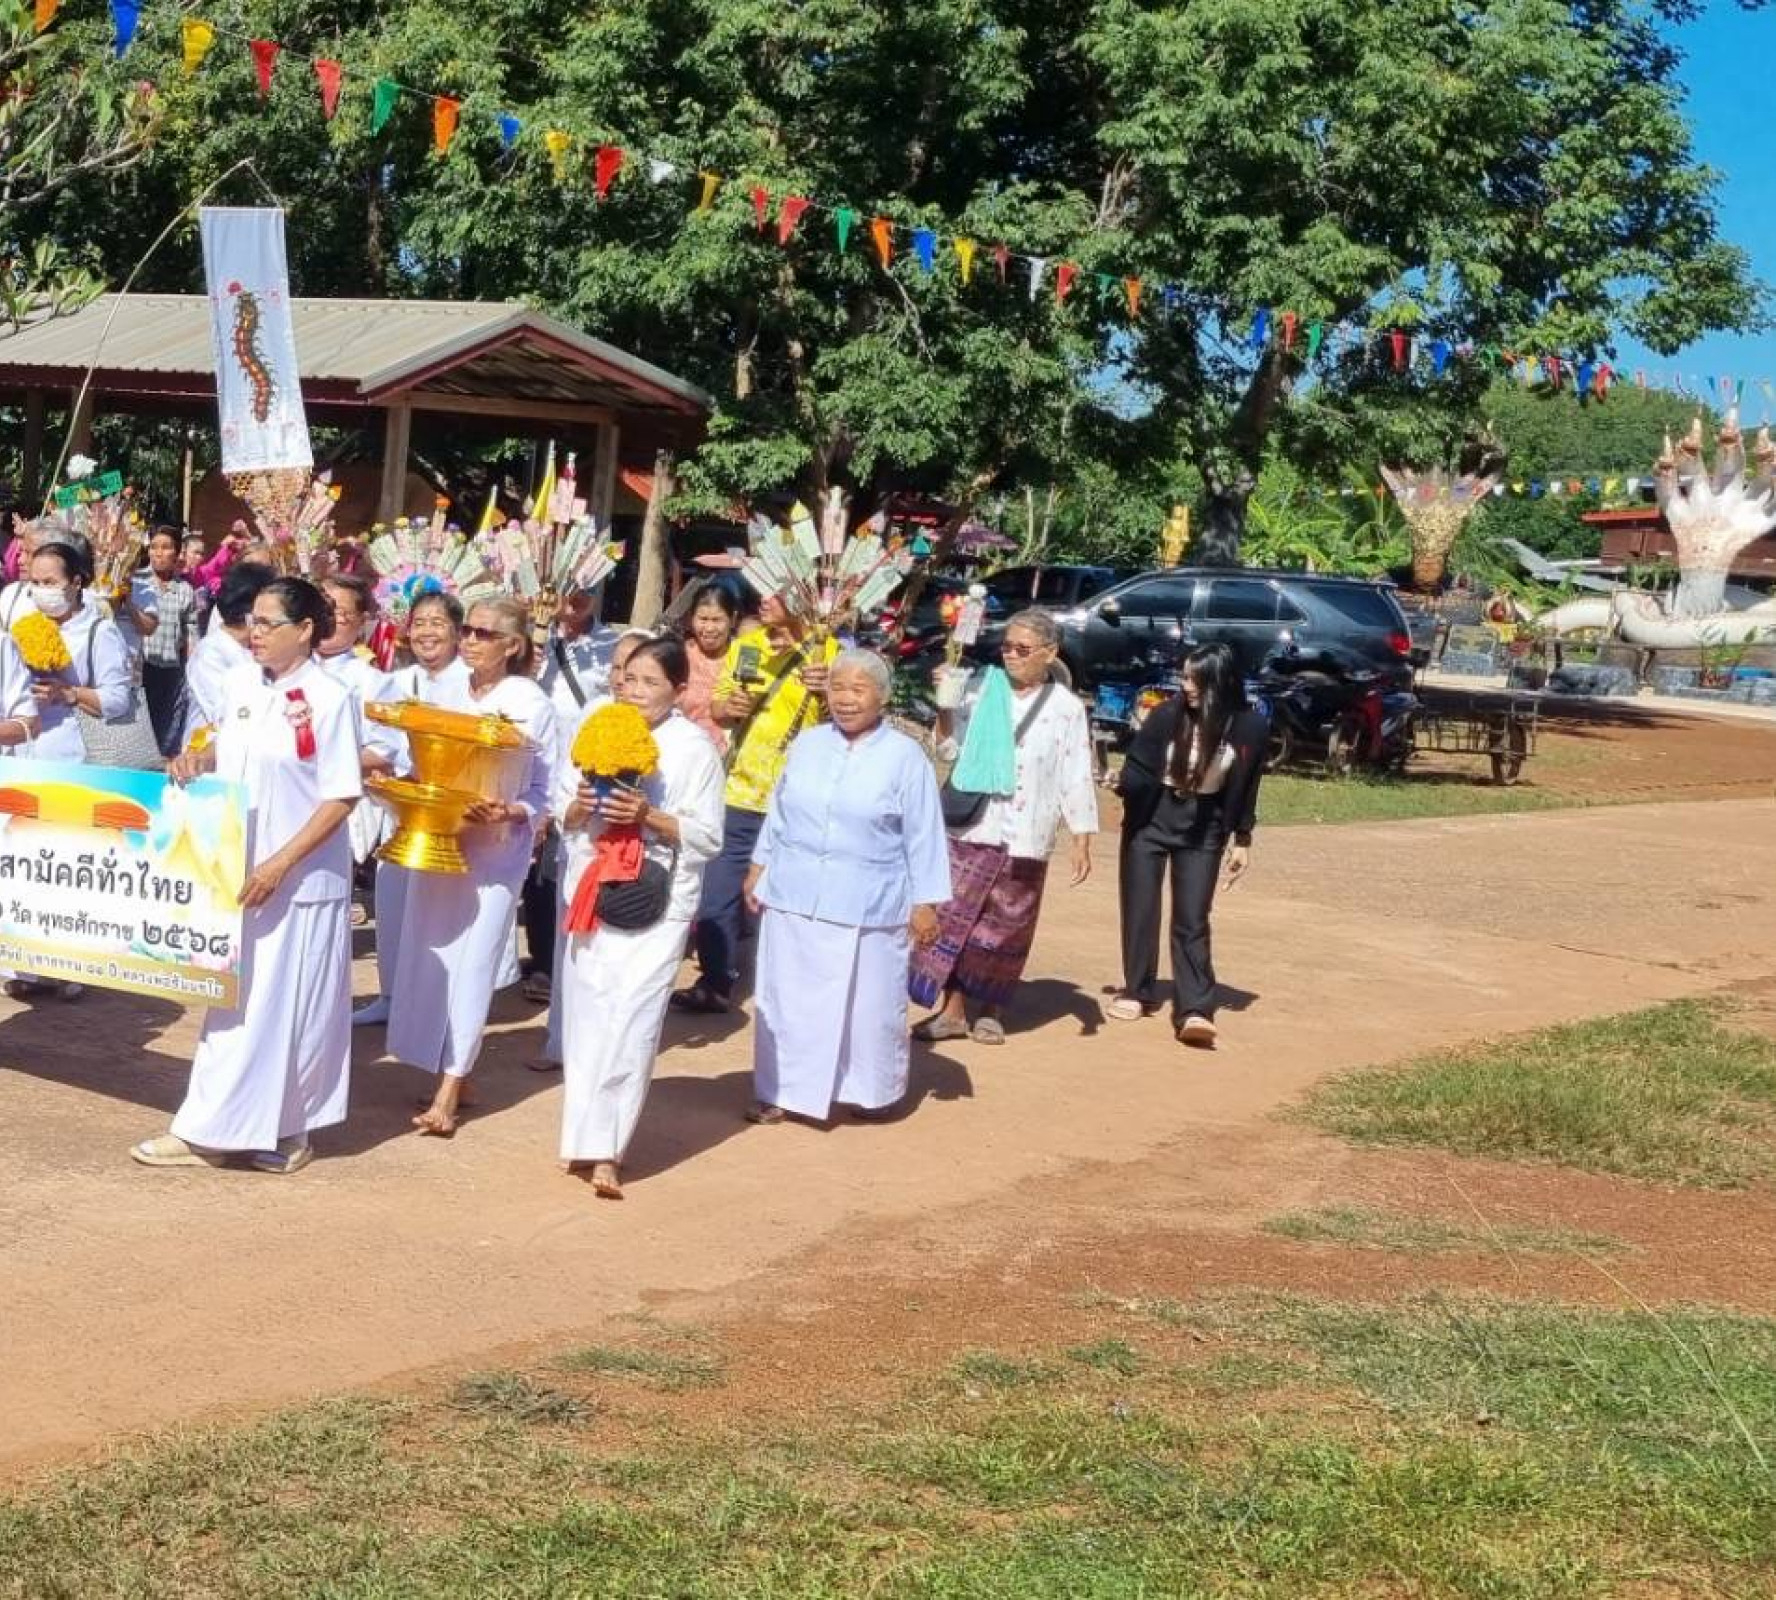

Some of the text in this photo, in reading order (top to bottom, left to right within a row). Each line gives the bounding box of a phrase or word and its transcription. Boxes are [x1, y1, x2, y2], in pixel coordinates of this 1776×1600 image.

[10, 900, 32, 924] วัด
[37, 909, 134, 942] พุทธศักราช
[142, 919, 230, 957] ๒๕๖๘
